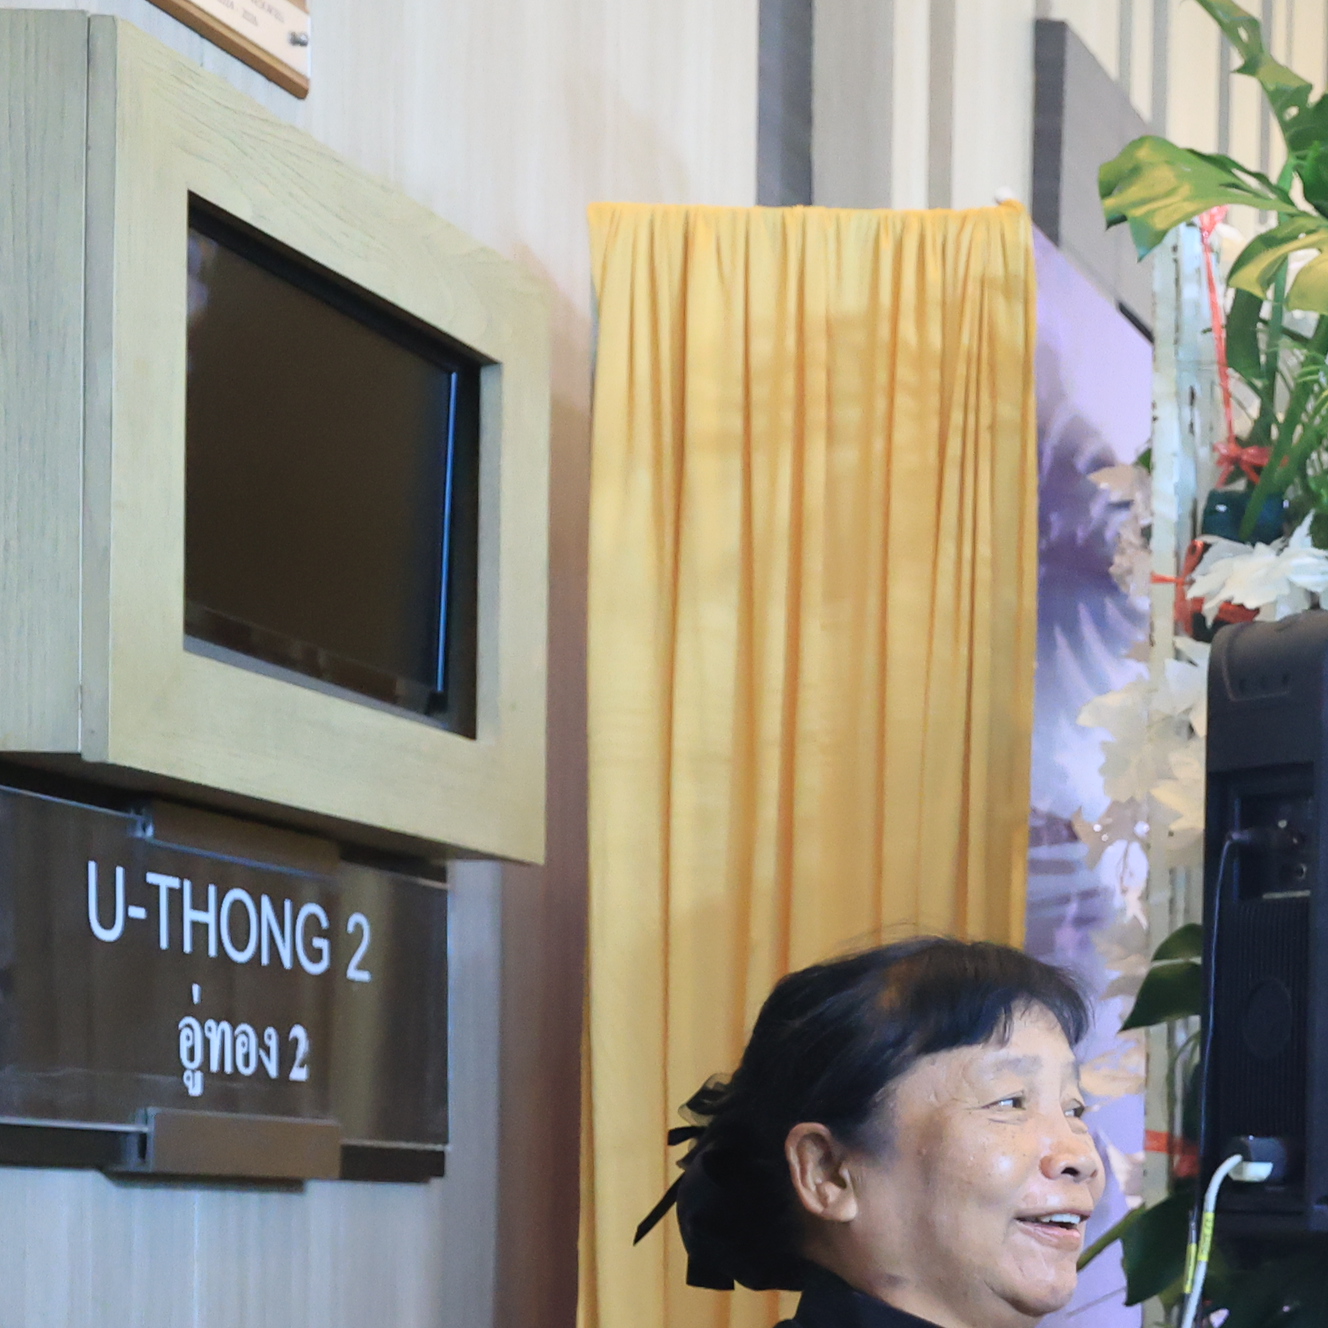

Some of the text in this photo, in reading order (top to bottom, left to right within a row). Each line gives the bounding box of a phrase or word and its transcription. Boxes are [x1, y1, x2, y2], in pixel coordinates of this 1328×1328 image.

[87, 860, 371, 982] U-THONG 2
[178, 983, 310, 1096] อู่ทอง 2
